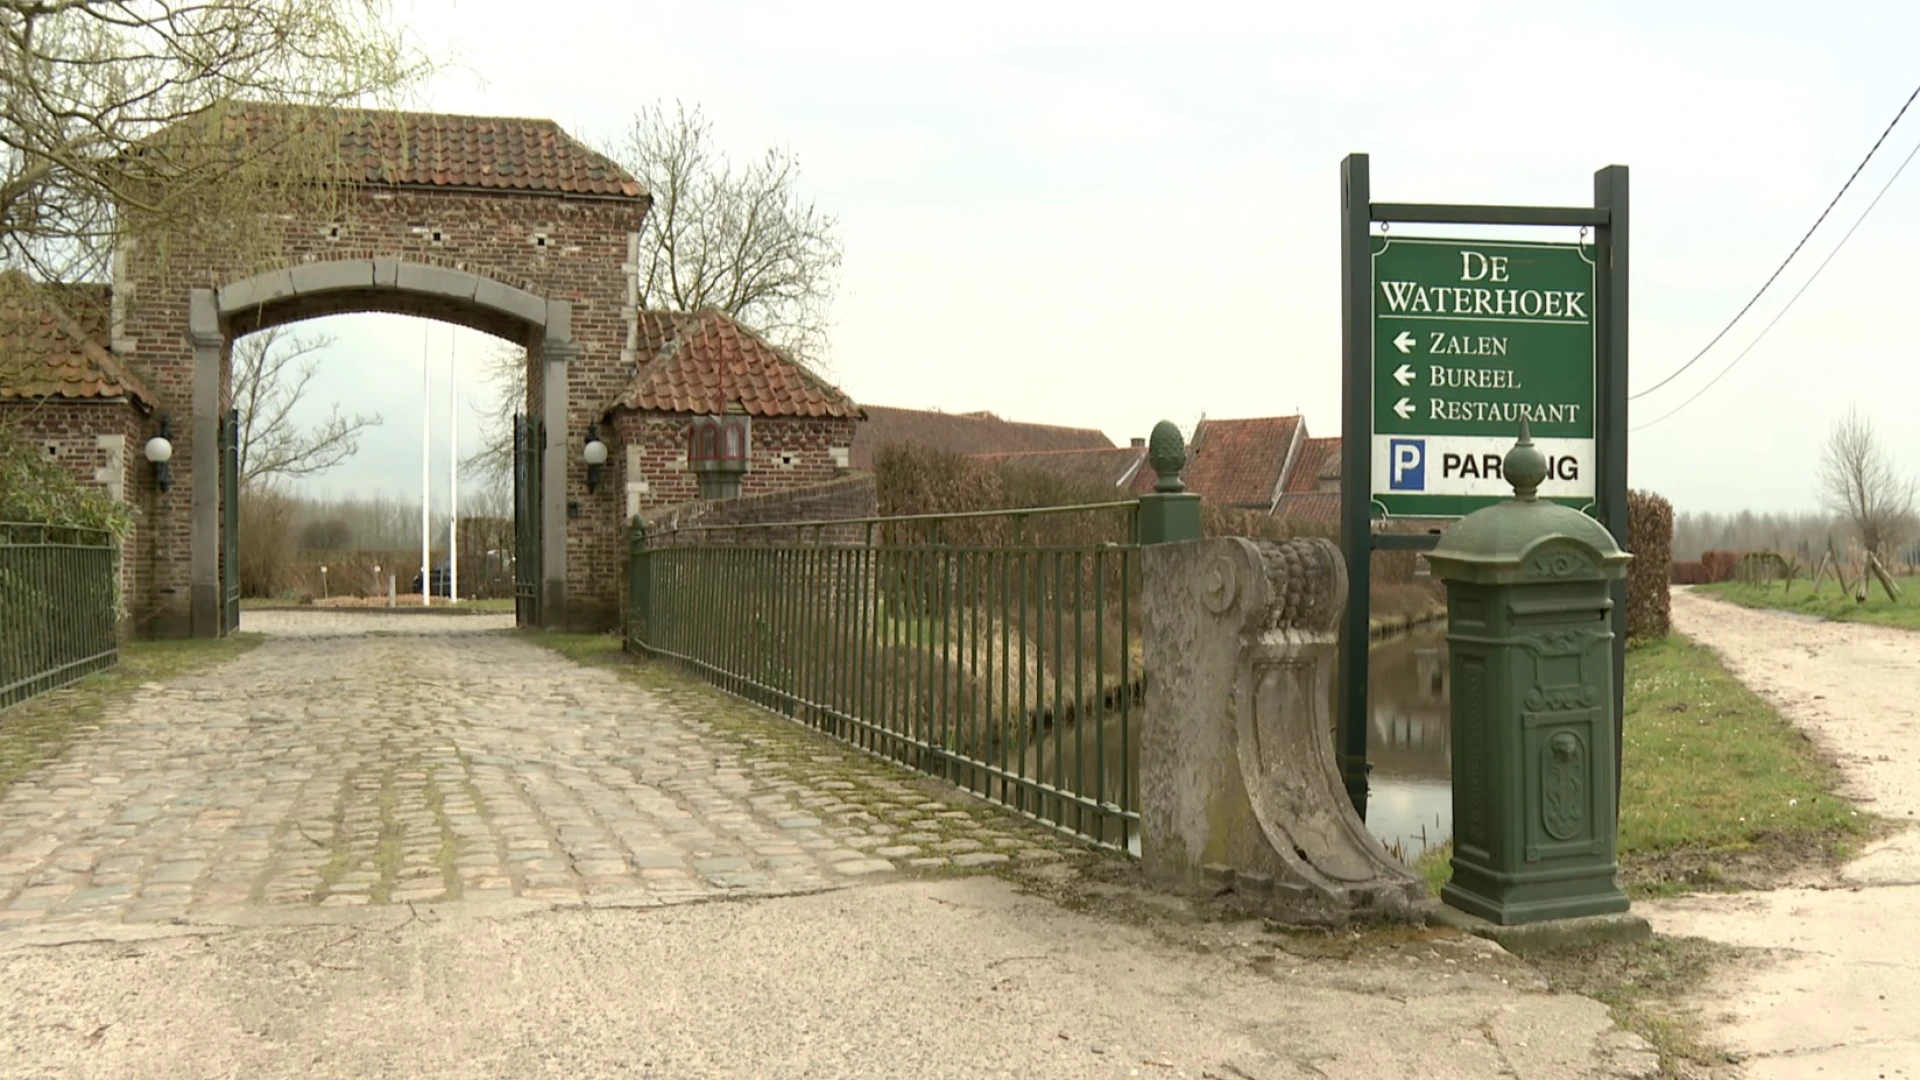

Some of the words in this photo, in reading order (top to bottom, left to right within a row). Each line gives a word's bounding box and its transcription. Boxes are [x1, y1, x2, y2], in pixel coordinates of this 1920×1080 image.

[1460, 250, 1509, 282] DE
[1380, 281, 1588, 318] WATERHOEK
[1429, 332, 1508, 356] ZALEN
[1429, 365, 1521, 389] BUREEL
[1429, 398, 1580, 423] RESTAURANT
[1394, 444, 1421, 483] P
[1442, 453, 1579, 481] PARG
